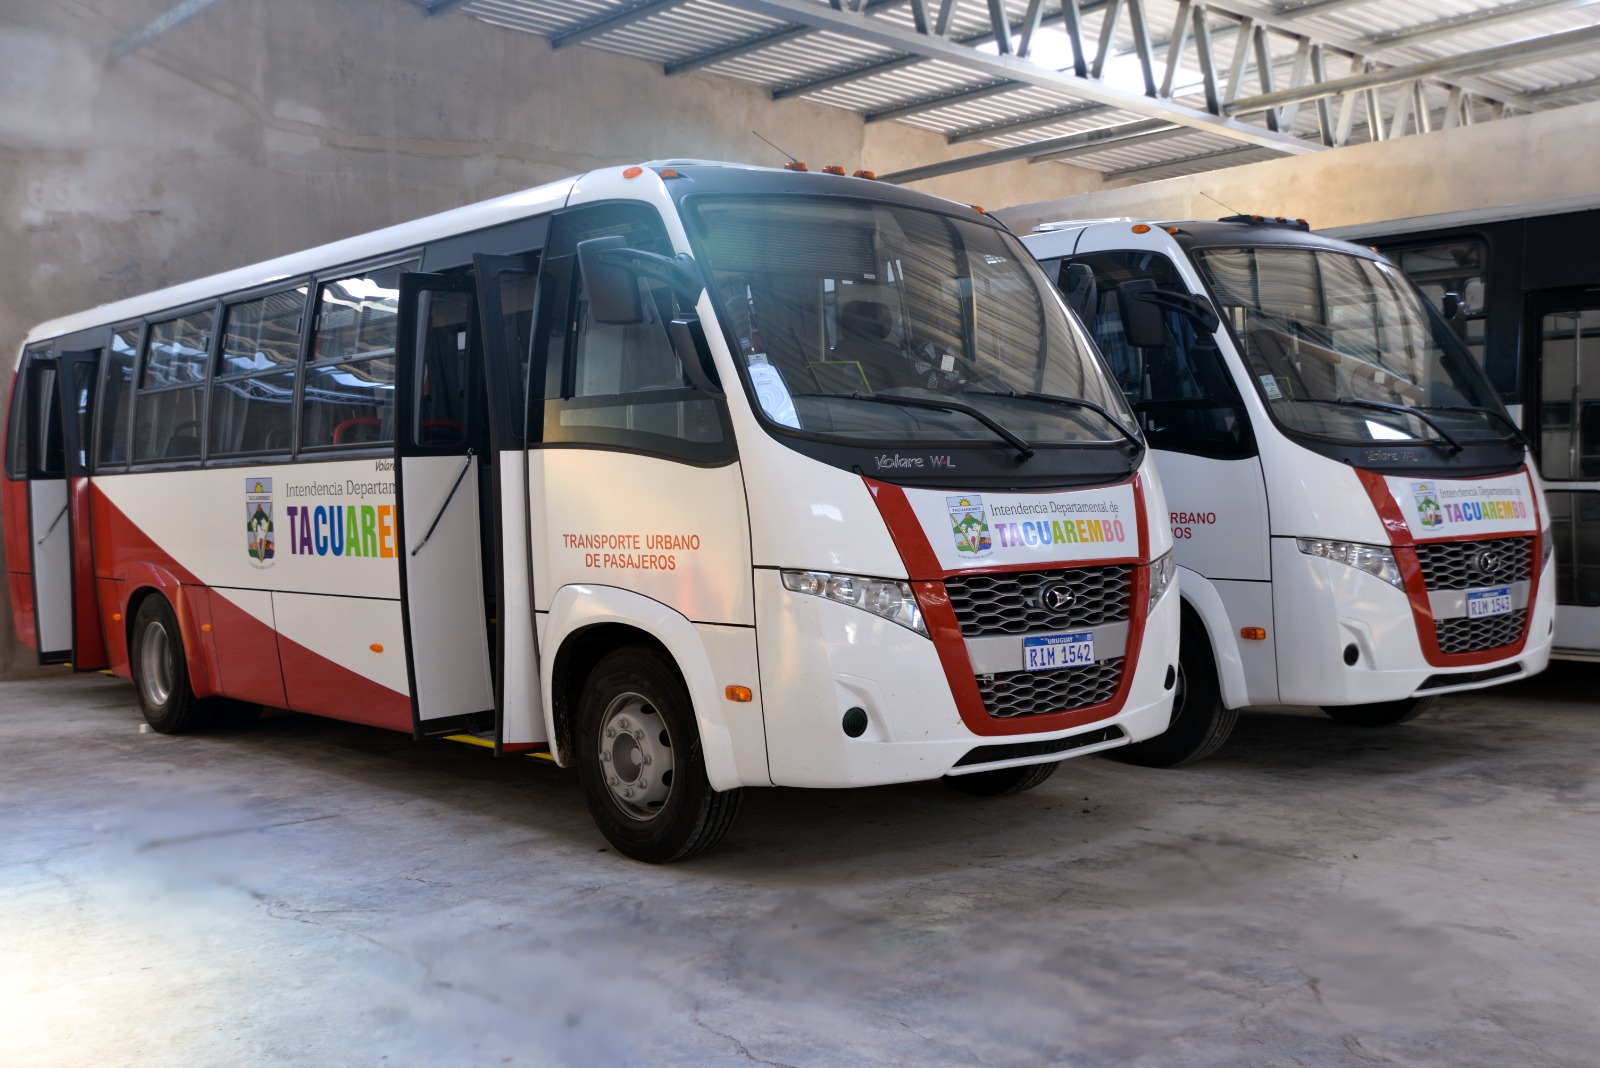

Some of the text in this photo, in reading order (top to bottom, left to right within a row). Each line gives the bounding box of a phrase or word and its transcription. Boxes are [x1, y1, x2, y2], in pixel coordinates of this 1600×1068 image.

[286, 481, 343, 498] Intendencia
[990, 501, 1119, 516] Intendencia Departamental de
[1444, 497, 1527, 523] TACUAREMBÓ
[1168, 511, 1216, 524] RBANO
[286, 504, 399, 559] TACUARE
[994, 514, 1125, 548] TACUAREMBÓ
[562, 534, 700, 550] TRANSPORTE URBANO
[585, 553, 676, 571] DE PASAJEROS
[1491, 596, 1510, 613] 1543
[1029, 643, 1091, 667] RIM 1542
